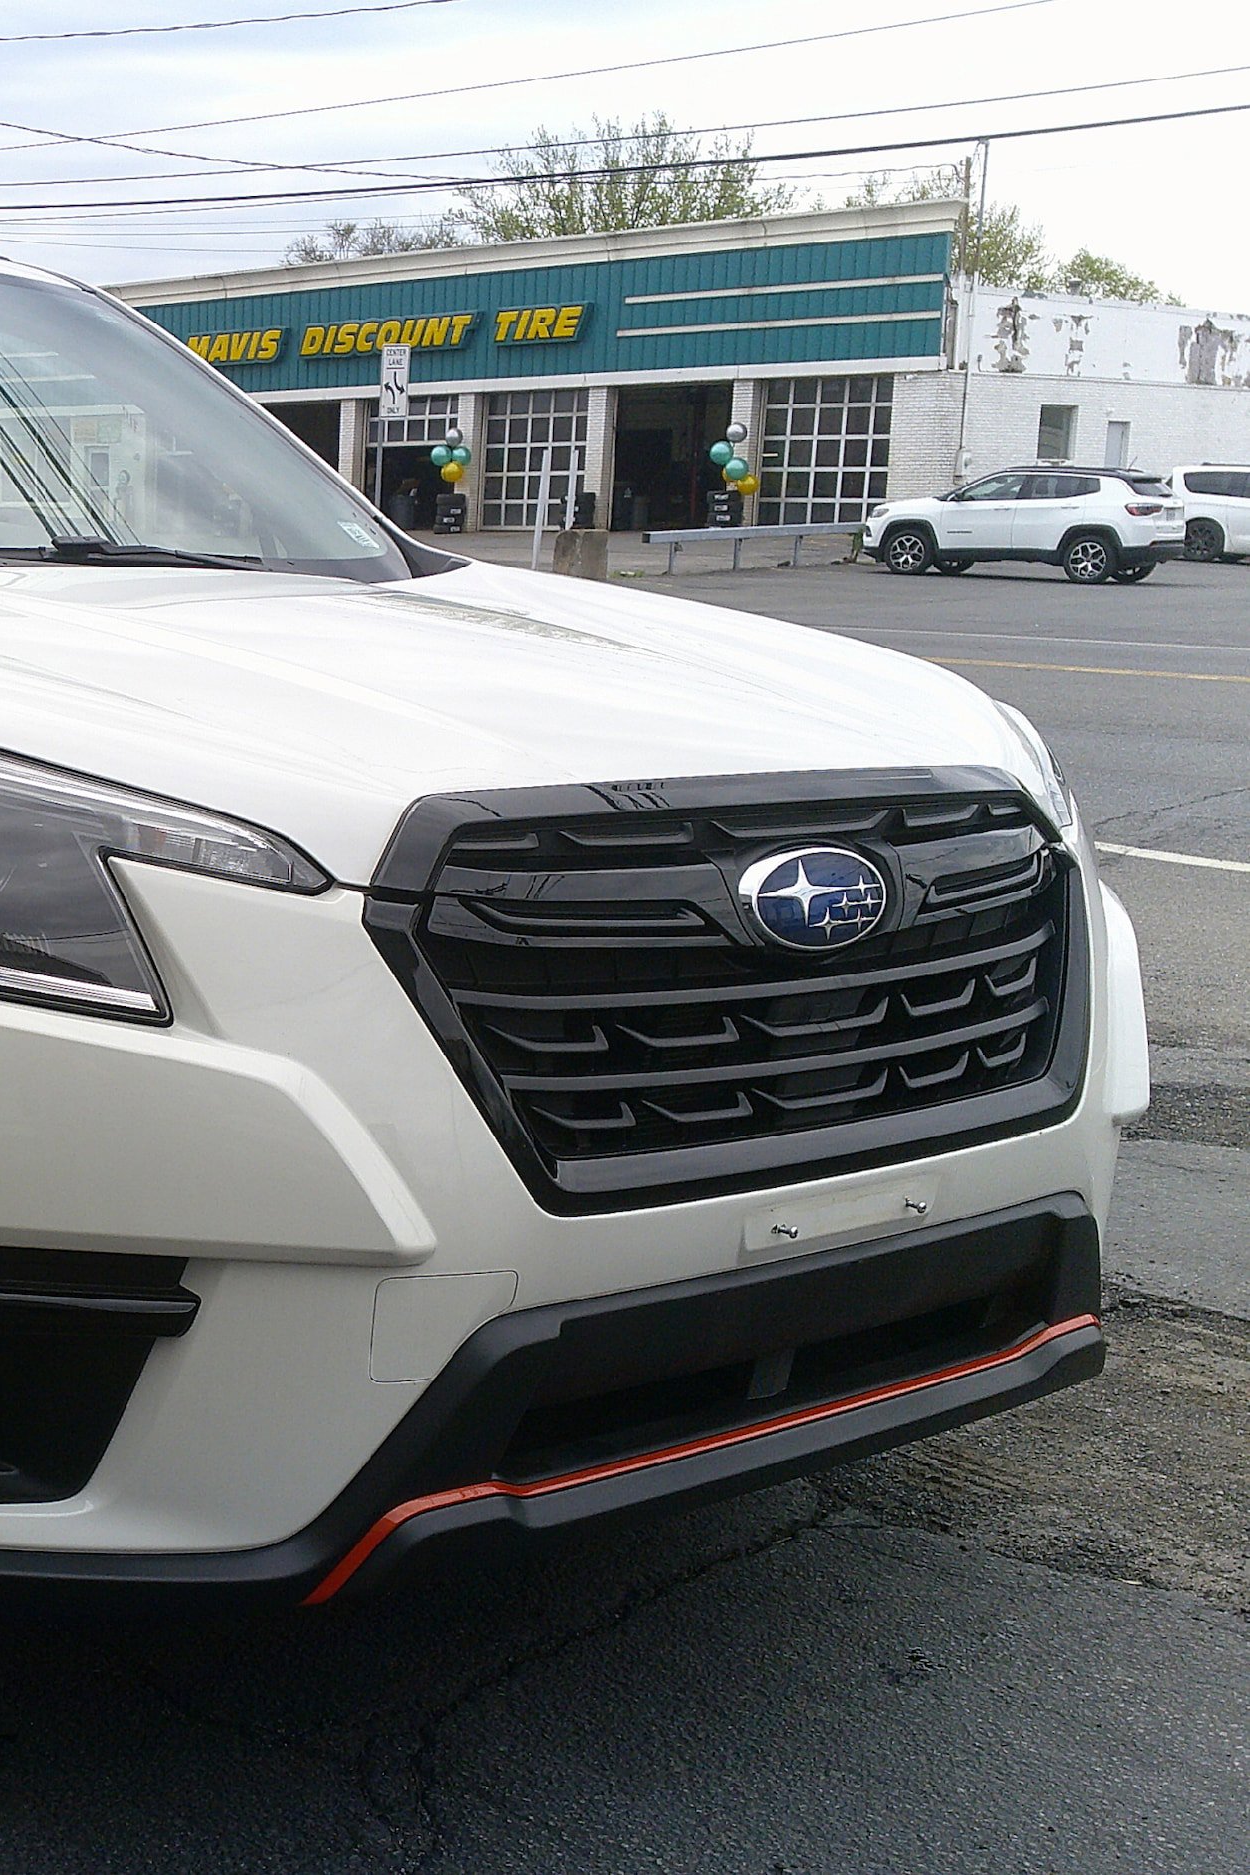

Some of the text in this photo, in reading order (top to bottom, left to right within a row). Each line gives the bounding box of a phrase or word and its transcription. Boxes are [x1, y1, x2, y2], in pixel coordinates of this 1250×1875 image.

[187, 305, 583, 362] MAVIS DISCOUNT TIRE
[386, 348, 406, 356] CENTER
[388, 358, 403, 366] LANE
